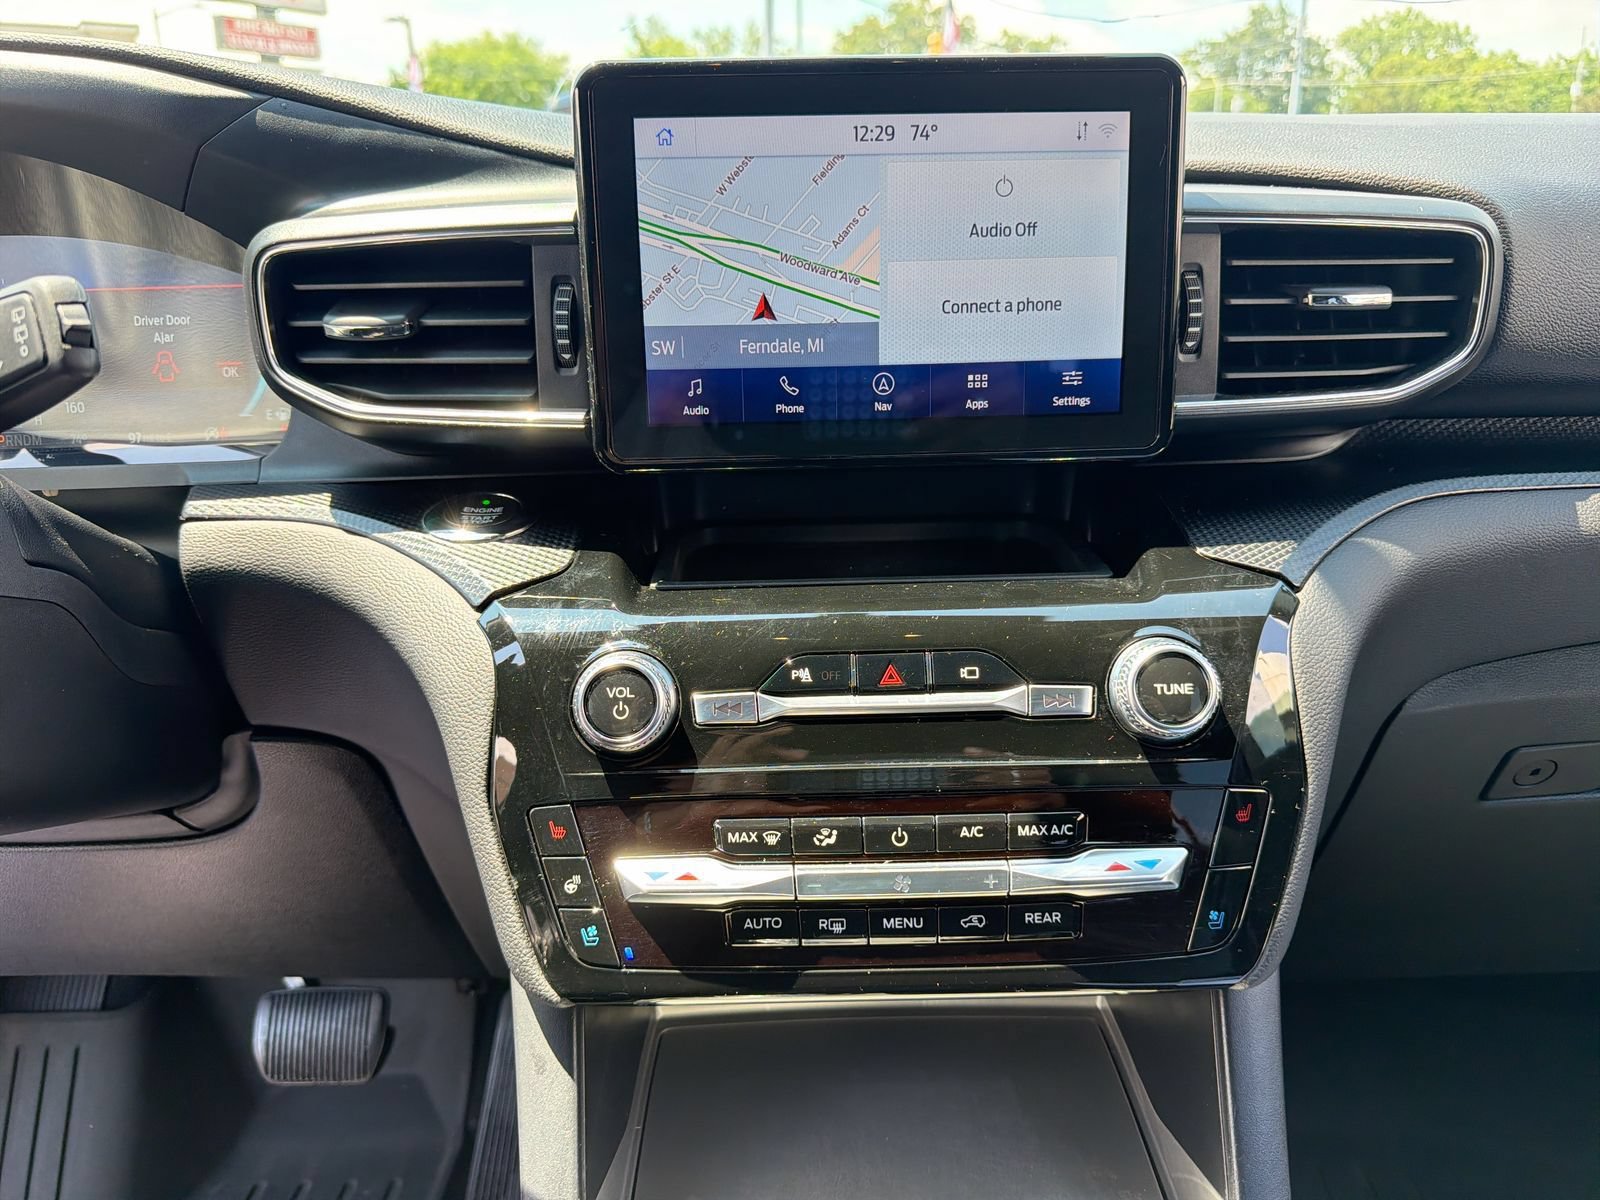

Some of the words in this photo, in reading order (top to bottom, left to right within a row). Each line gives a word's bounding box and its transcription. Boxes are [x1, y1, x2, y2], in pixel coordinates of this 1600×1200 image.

[853, 124, 895, 142] 12:29
[910, 124, 938, 141] 74°
[716, 183, 728, 196] W
[832, 217, 860, 249] Adams
[857, 205, 870, 218] Ct
[969, 223, 1012, 238] Audio
[1015, 222, 1038, 238] Off
[662, 272, 675, 285] St
[671, 264, 682, 275] E
[779, 252, 840, 279] Woodward
[839, 272, 861, 286] Ave
[942, 299, 1001, 314] Connect
[1005, 302, 1013, 312] a
[1017, 298, 1062, 315] phone
[134, 315, 164, 327] Driver
[166, 315, 191, 326] Door
[154, 332, 175, 344] Ajar
[652, 341, 675, 355] SW
[739, 339, 805, 355] Ferndale,
[808, 338, 824, 353] MI
[223, 366, 239, 378] OK
[874, 401, 892, 411] Nav
[966, 399, 989, 411] Apps
[1052, 395, 1091, 407] Settings
[65, 402, 85, 413] 160
[683, 405, 710, 416] Audio
[775, 403, 805, 413] Phone
[821, 671, 841, 681] OFF
[606, 686, 635, 698] VOL
[1153, 683, 1195, 695] TUNE
[960, 826, 984, 838] A/C
[1017, 825, 1048, 837] MAX
[1050, 824, 1074, 836] A/C
[728, 832, 758, 843] MAX
[743, 917, 783, 929] AUTO
[883, 917, 924, 929] MENU
[1025, 912, 1061, 924] REAR
